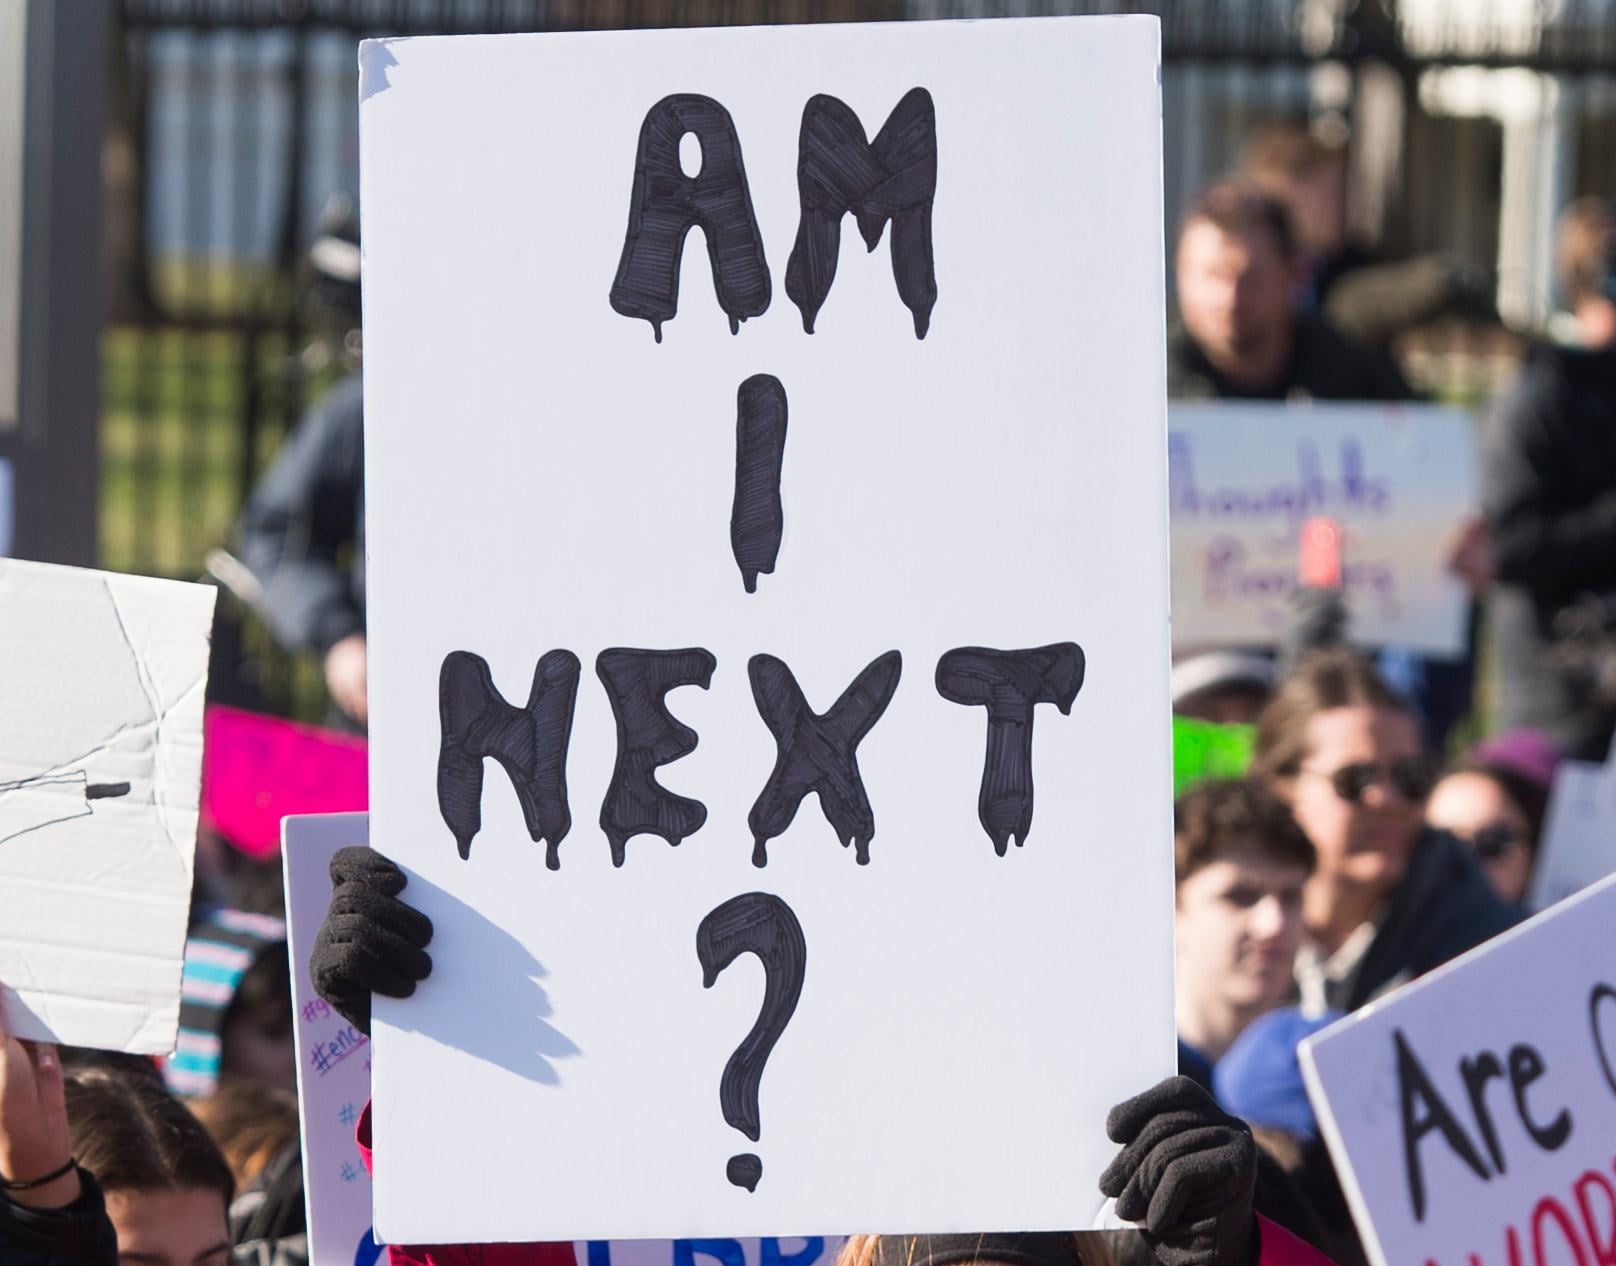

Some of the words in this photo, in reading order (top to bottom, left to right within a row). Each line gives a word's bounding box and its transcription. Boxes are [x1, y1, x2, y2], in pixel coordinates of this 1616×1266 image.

[608, 86, 938, 343] AM
[729, 372, 789, 594] I
[436, 641, 1086, 871] NEXT
[696, 891, 807, 1193] ?
[1390, 1027, 1574, 1223] Are
